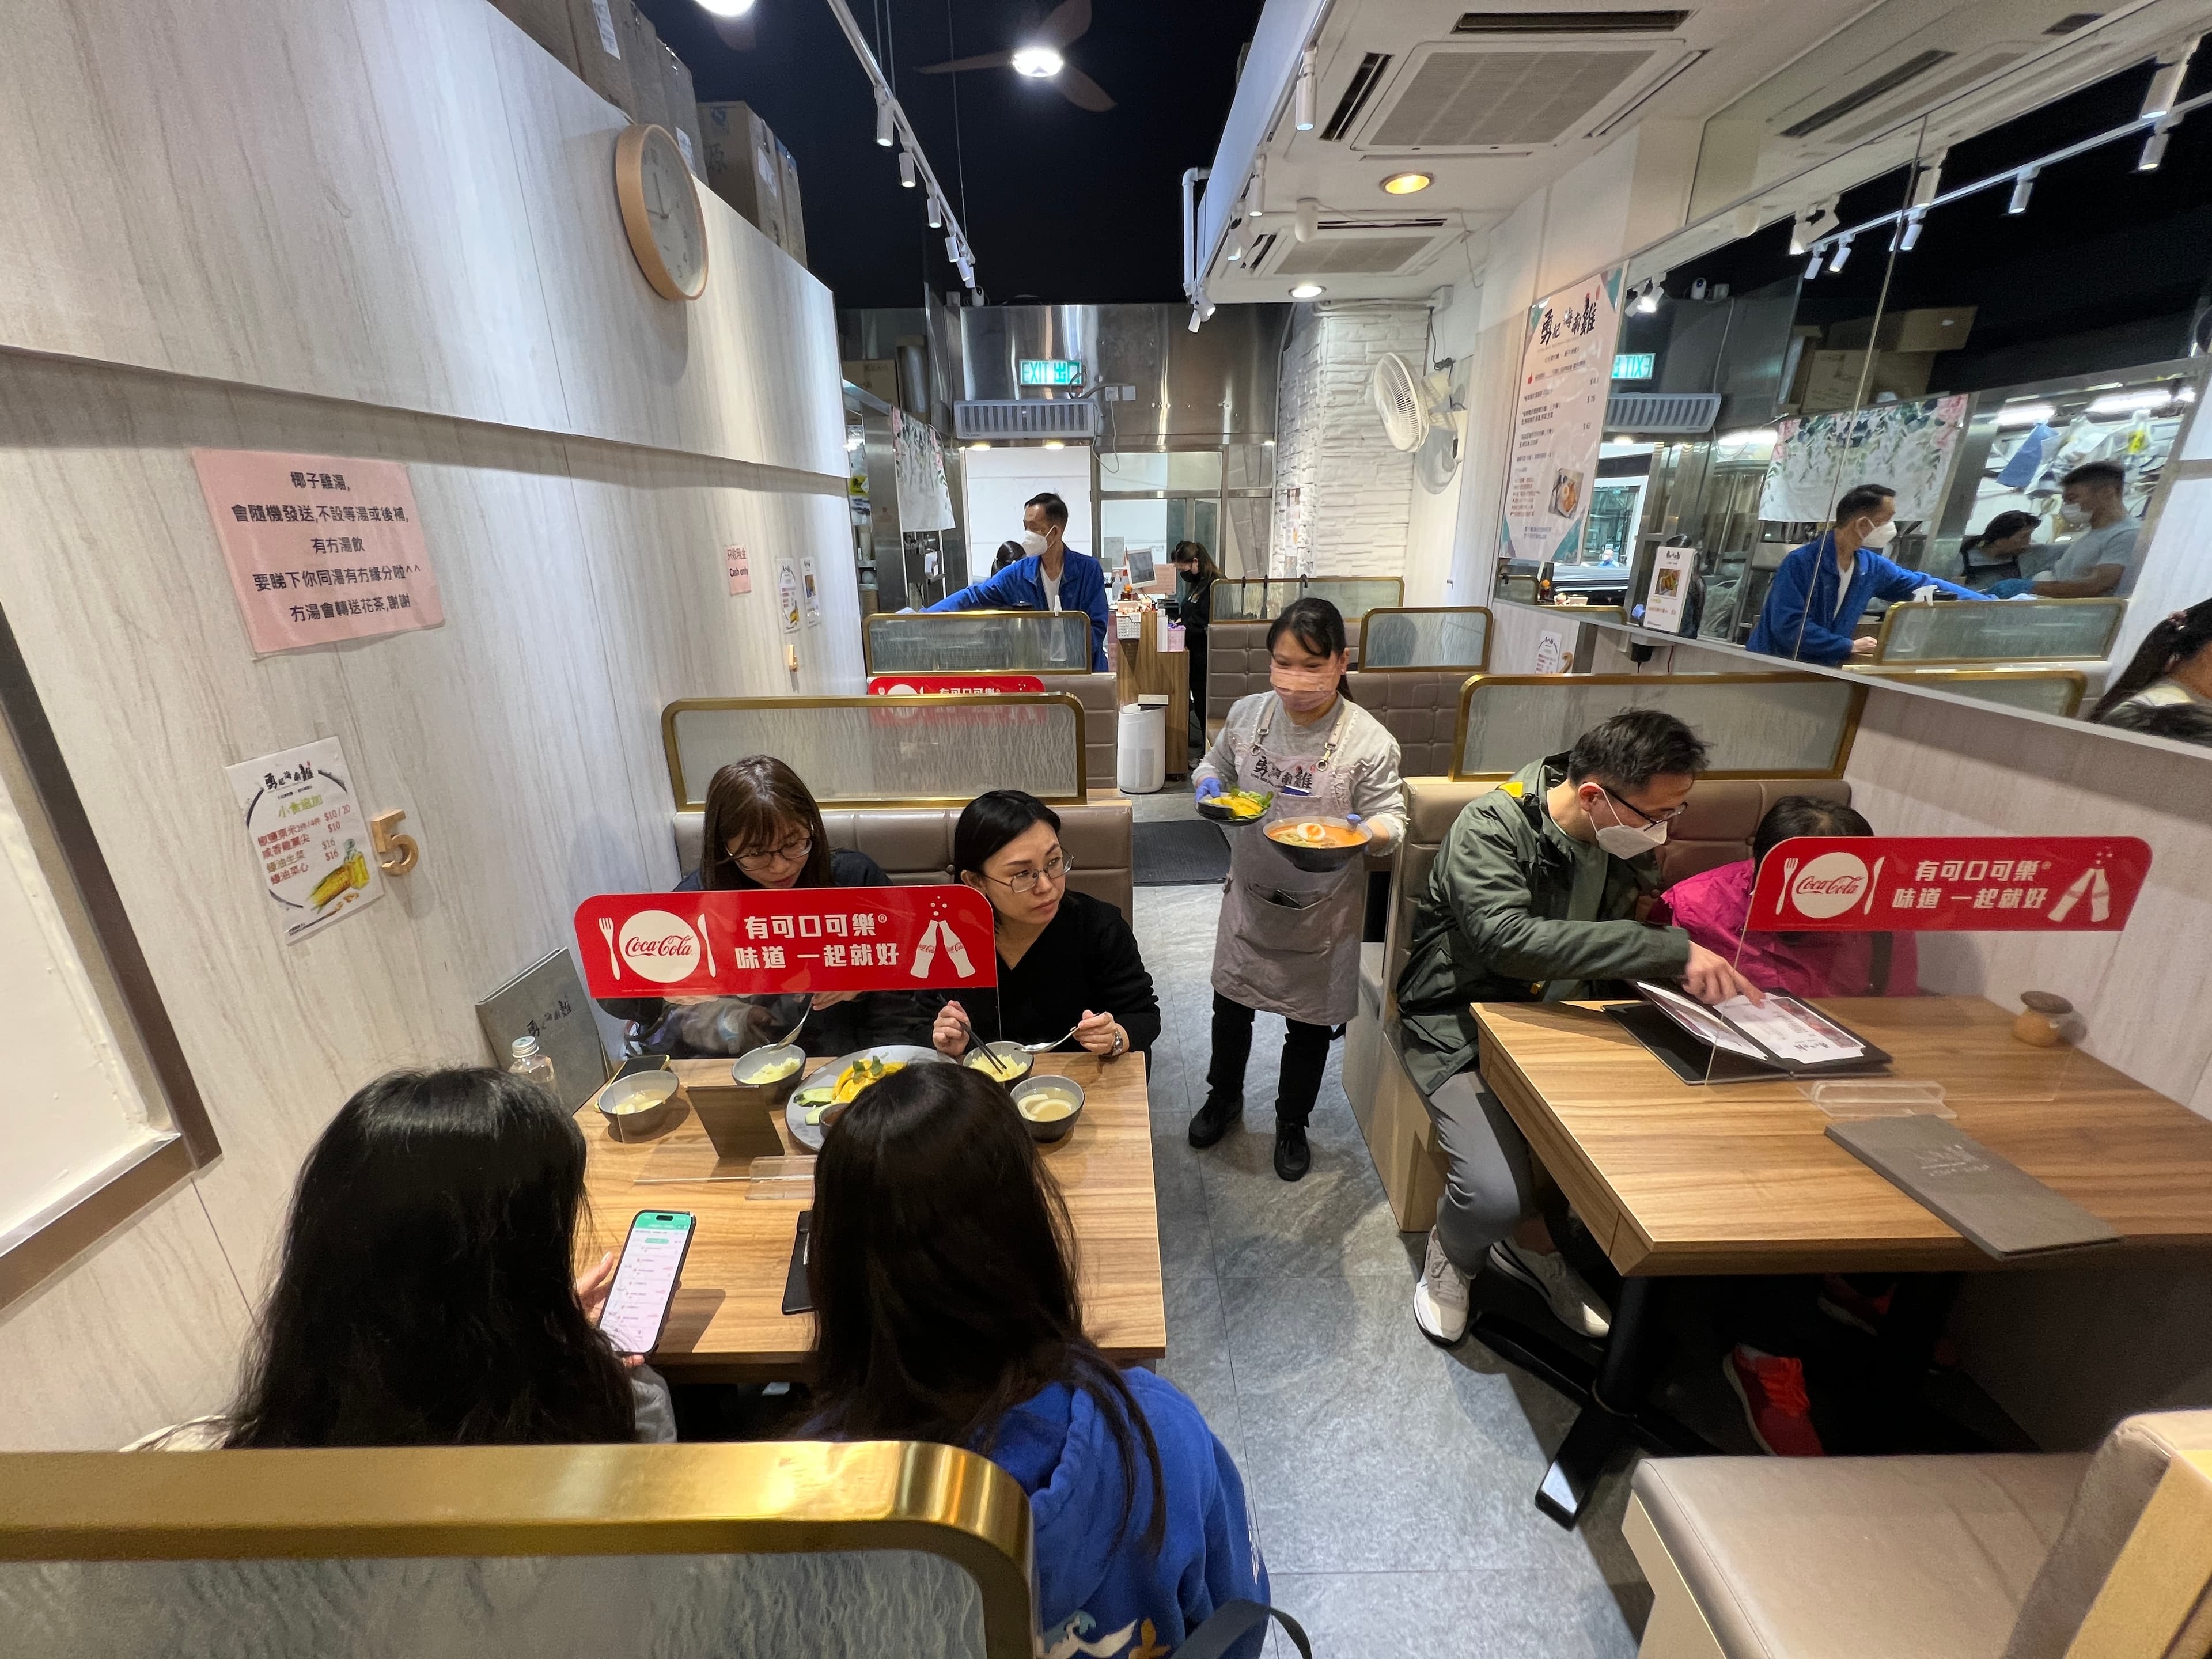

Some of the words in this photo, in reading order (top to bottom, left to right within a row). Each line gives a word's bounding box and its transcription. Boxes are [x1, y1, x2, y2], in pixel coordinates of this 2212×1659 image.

[1022, 362, 1049, 384] EXIT
[1054, 362, 1080, 384] 出口
[311, 536, 365, 554] 有冇湯飲
[729, 567, 739, 577] Cash
[370, 809, 419, 876] 5
[1796, 876, 1865, 895] Coca-Cola
[1892, 888, 1942, 908] 味道
[1950, 888, 2048, 908] 一起就好
[625, 935, 694, 957] Coca-Cola
[734, 946, 786, 969] 味道
[797, 942, 899, 967] 一起就好
